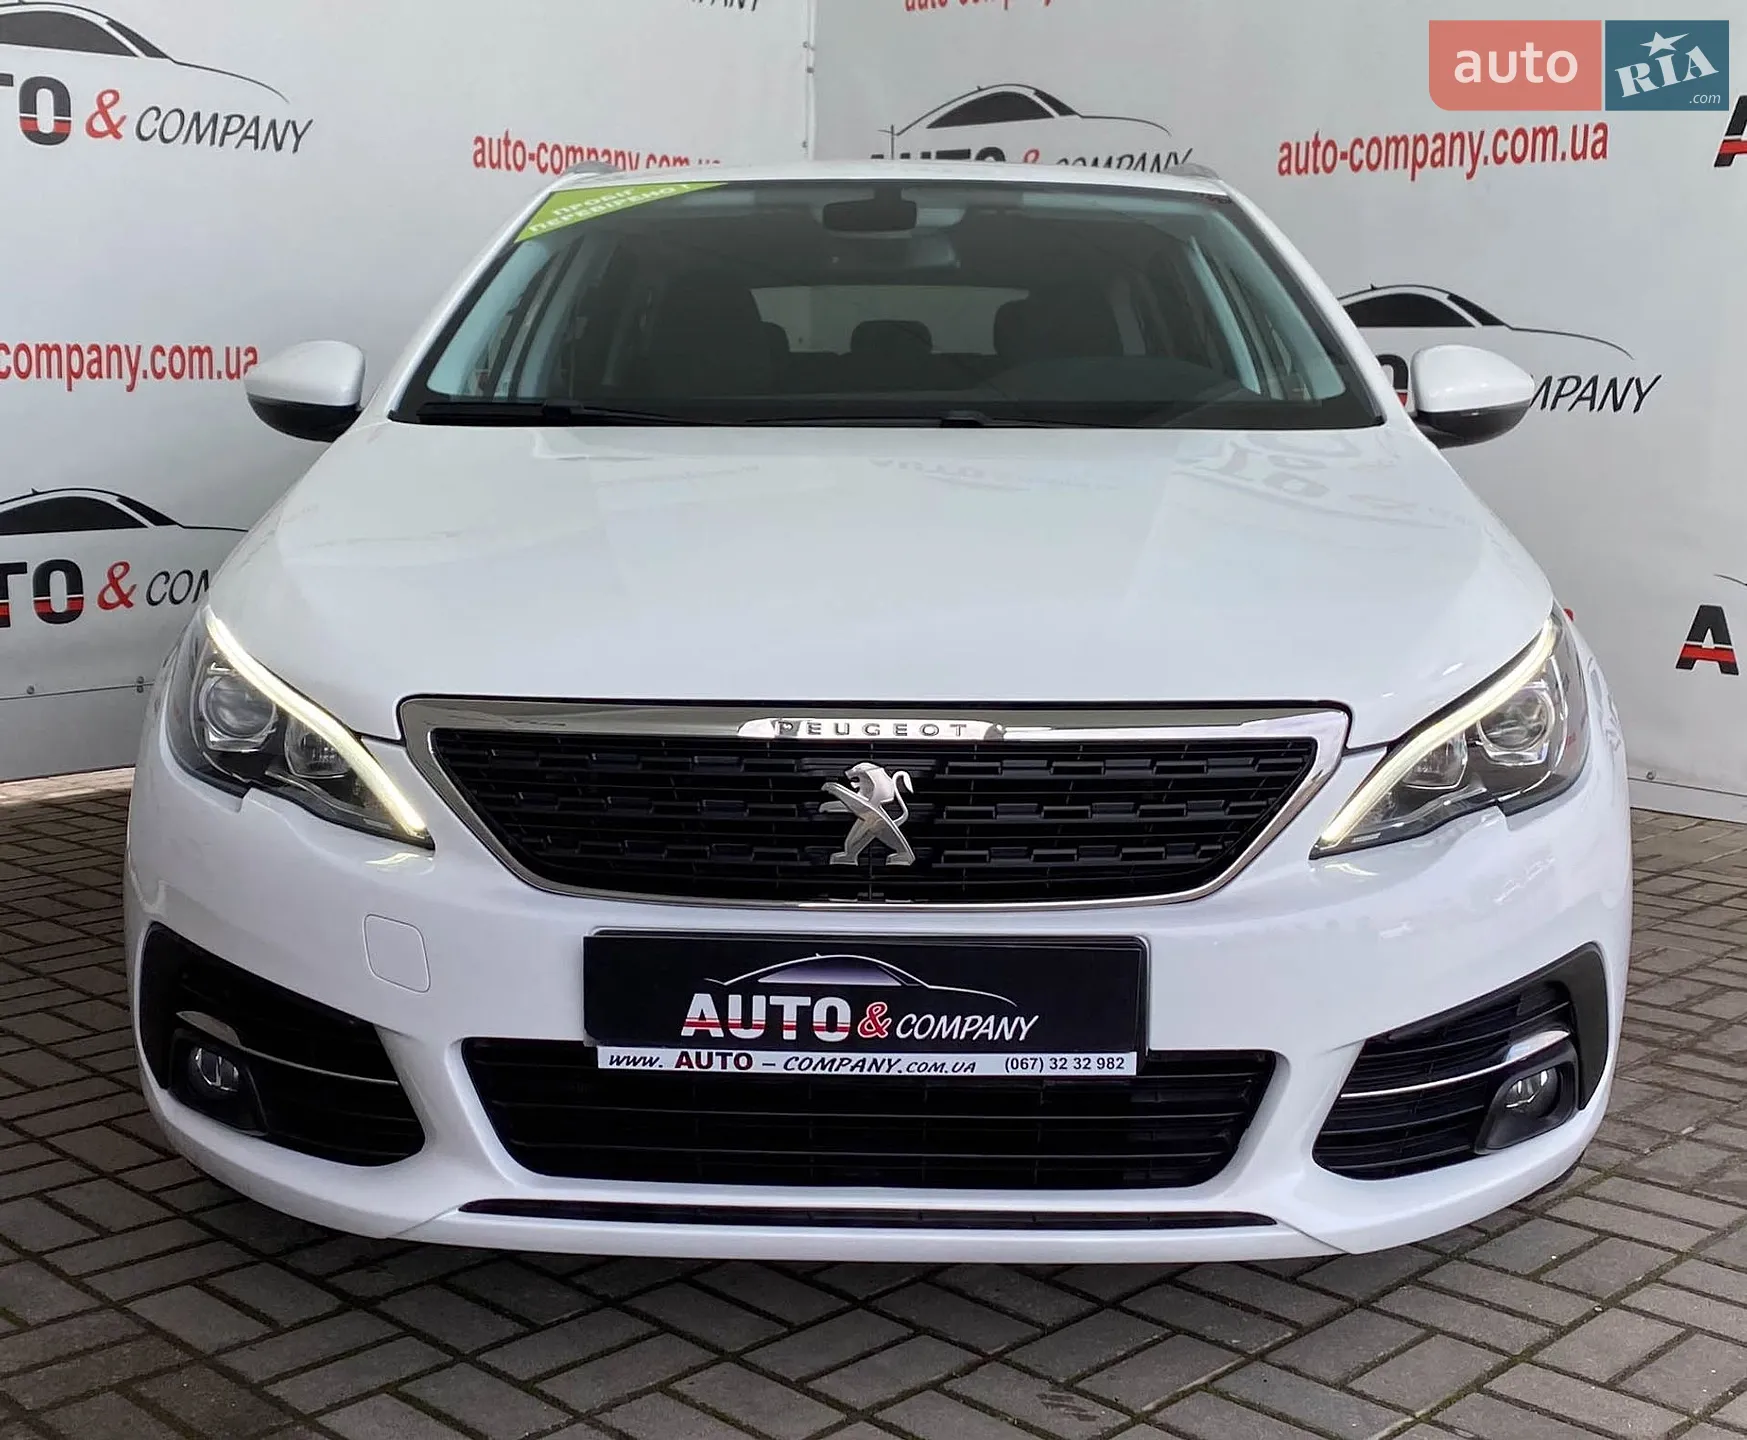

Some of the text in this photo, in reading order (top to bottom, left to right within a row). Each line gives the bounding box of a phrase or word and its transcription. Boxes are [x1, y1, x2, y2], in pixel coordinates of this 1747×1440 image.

[85, 89, 127, 140] &
[135, 105, 314, 154] COMPANY
[1278, 121, 1608, 181] auto-company.com.ua
[97, 560, 137, 611] &
[776, 720, 967, 738] PEUGEOT
[681, 993, 1039, 1042] AUTO & COMPANY
[674, 1050, 754, 1071] AUTO
[1004, 1056, 1044, 1074] (067)
[1049, 1057, 1069, 1071] 32
[1073, 1057, 1092, 1071] 32
[1096, 1058, 1125, 1071] 982
